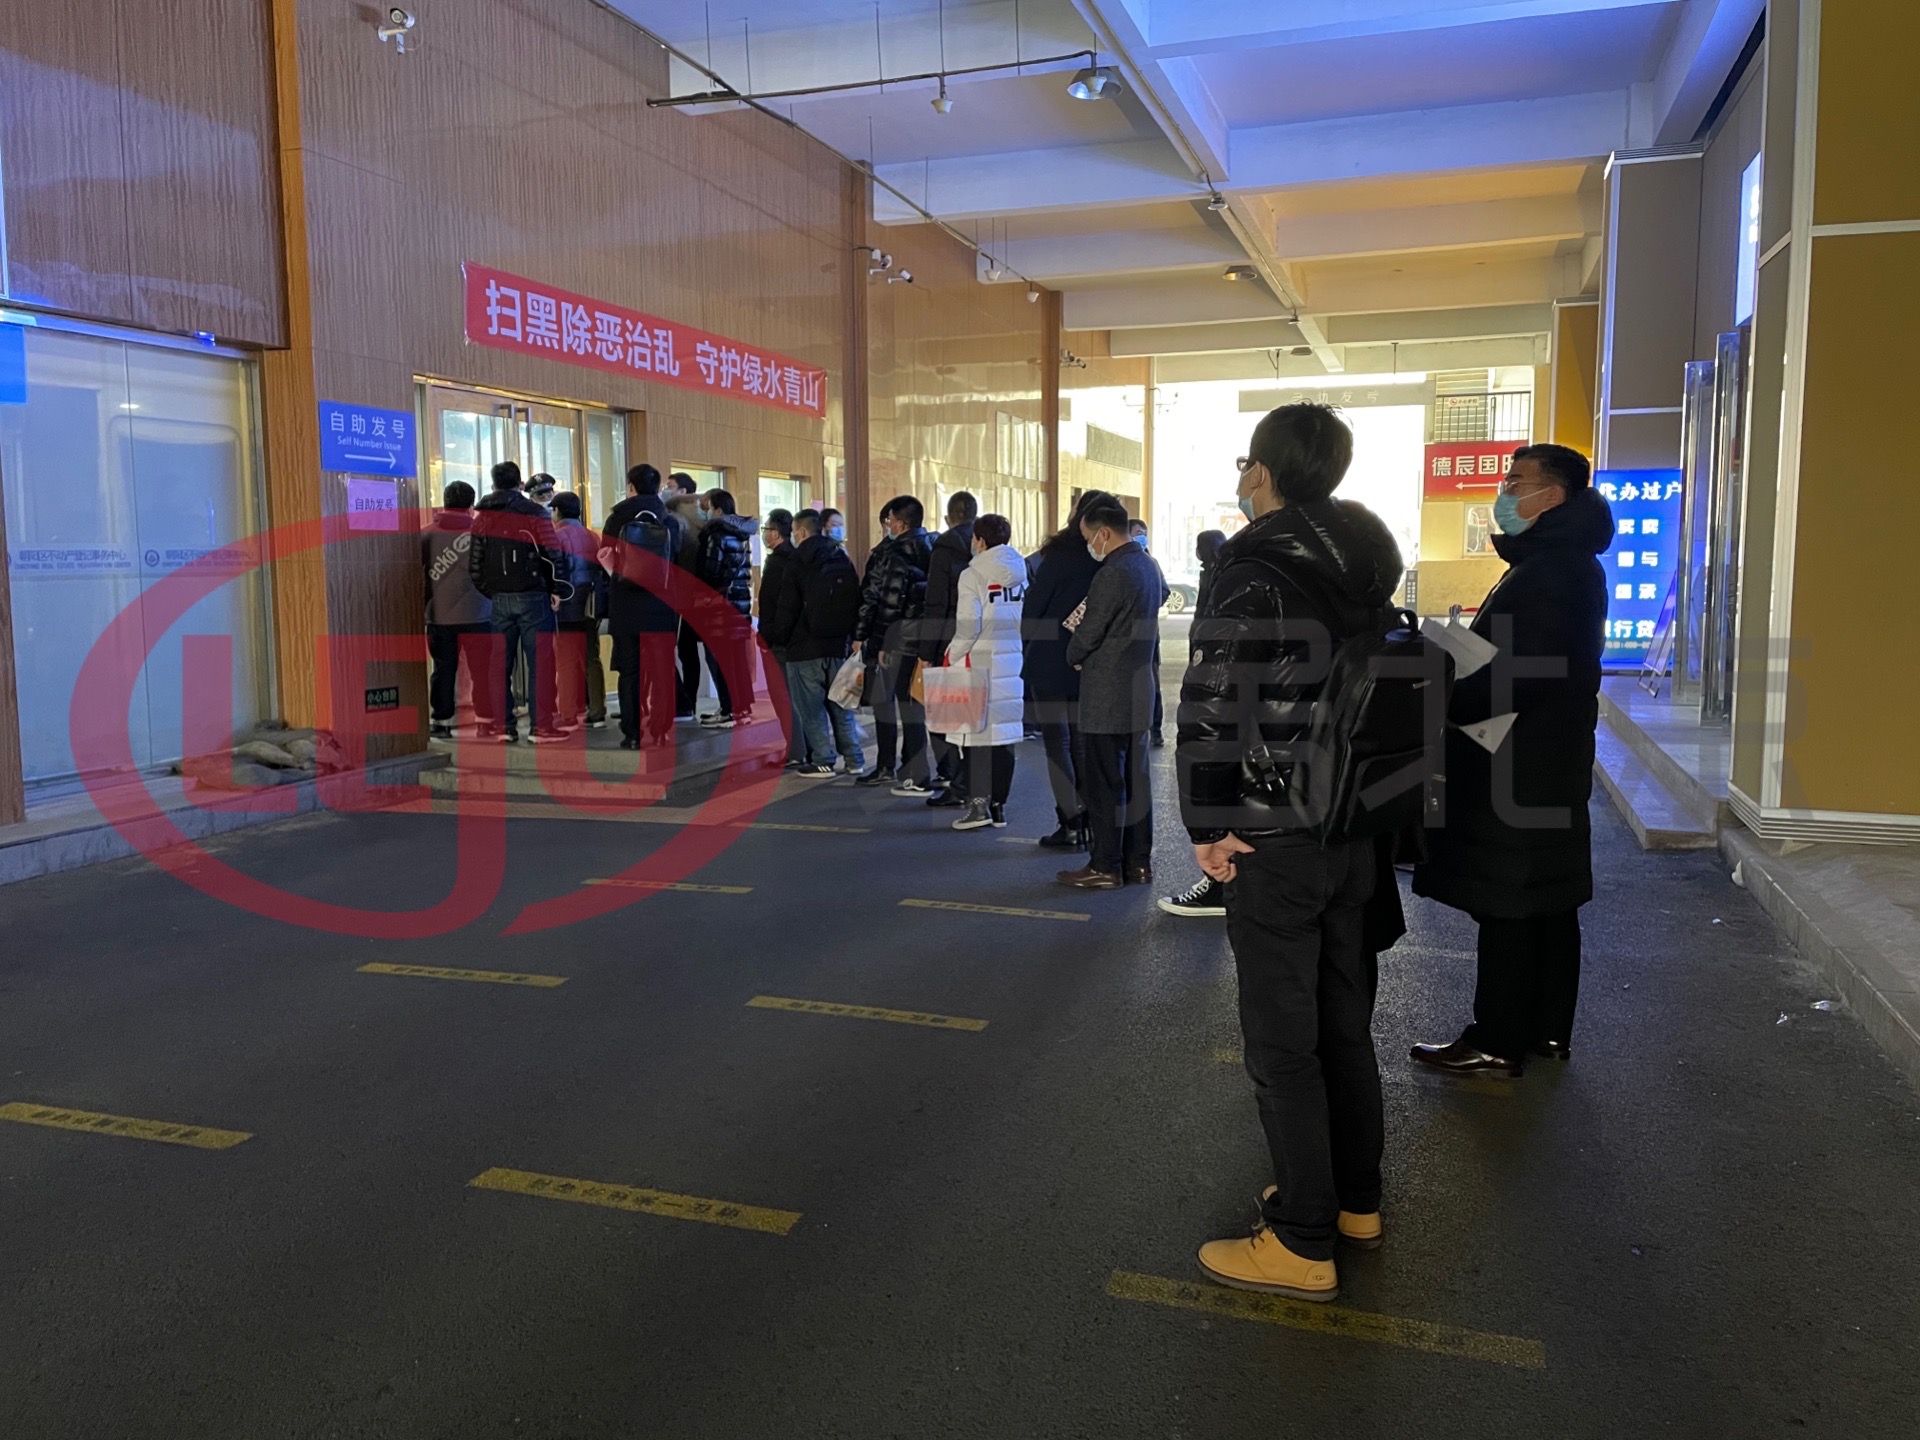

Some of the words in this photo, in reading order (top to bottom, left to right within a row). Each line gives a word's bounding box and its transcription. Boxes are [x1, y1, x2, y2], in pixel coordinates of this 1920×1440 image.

[485, 279, 680, 377] 扫黑除恶治乱
[695, 340, 818, 411] 守护绿水青山
[331, 411, 405, 439] 自助发号
[353, 437, 383, 450] Number
[1599, 481, 1682, 501] 代办过户
[355, 497, 394, 513] 自助发号
